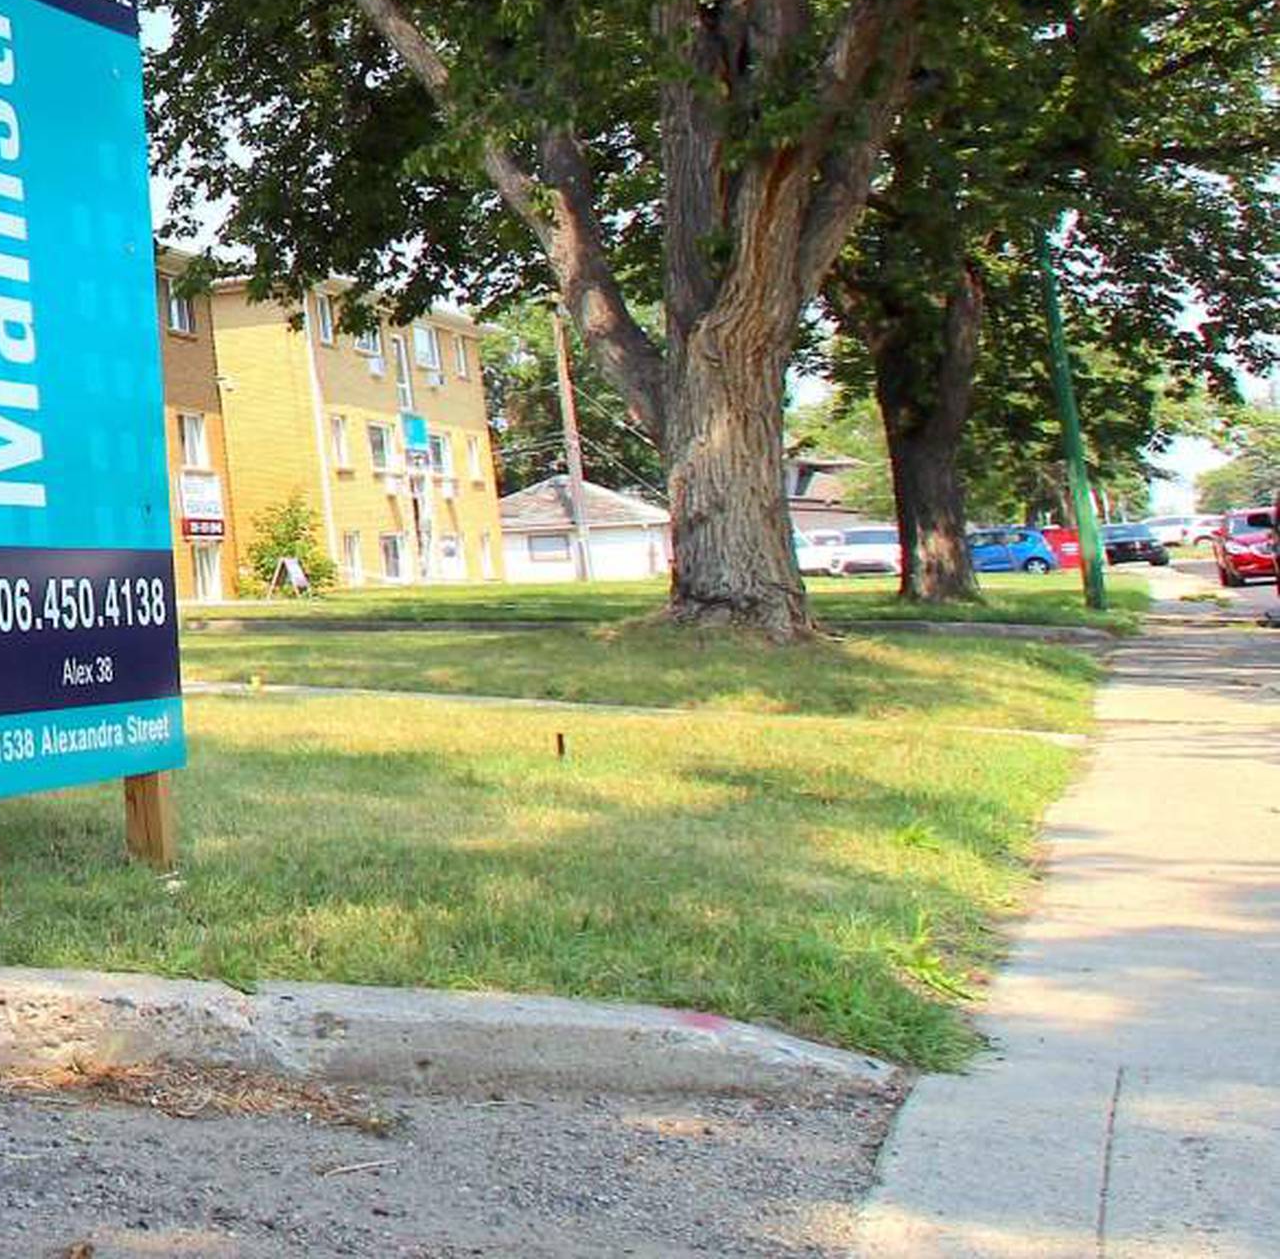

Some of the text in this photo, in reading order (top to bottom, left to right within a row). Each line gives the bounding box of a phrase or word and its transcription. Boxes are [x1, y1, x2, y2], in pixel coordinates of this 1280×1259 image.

[62, 656, 114, 685] Alex 38
[41, 718, 125, 757] Alexandra
[126, 711, 171, 746] Street
